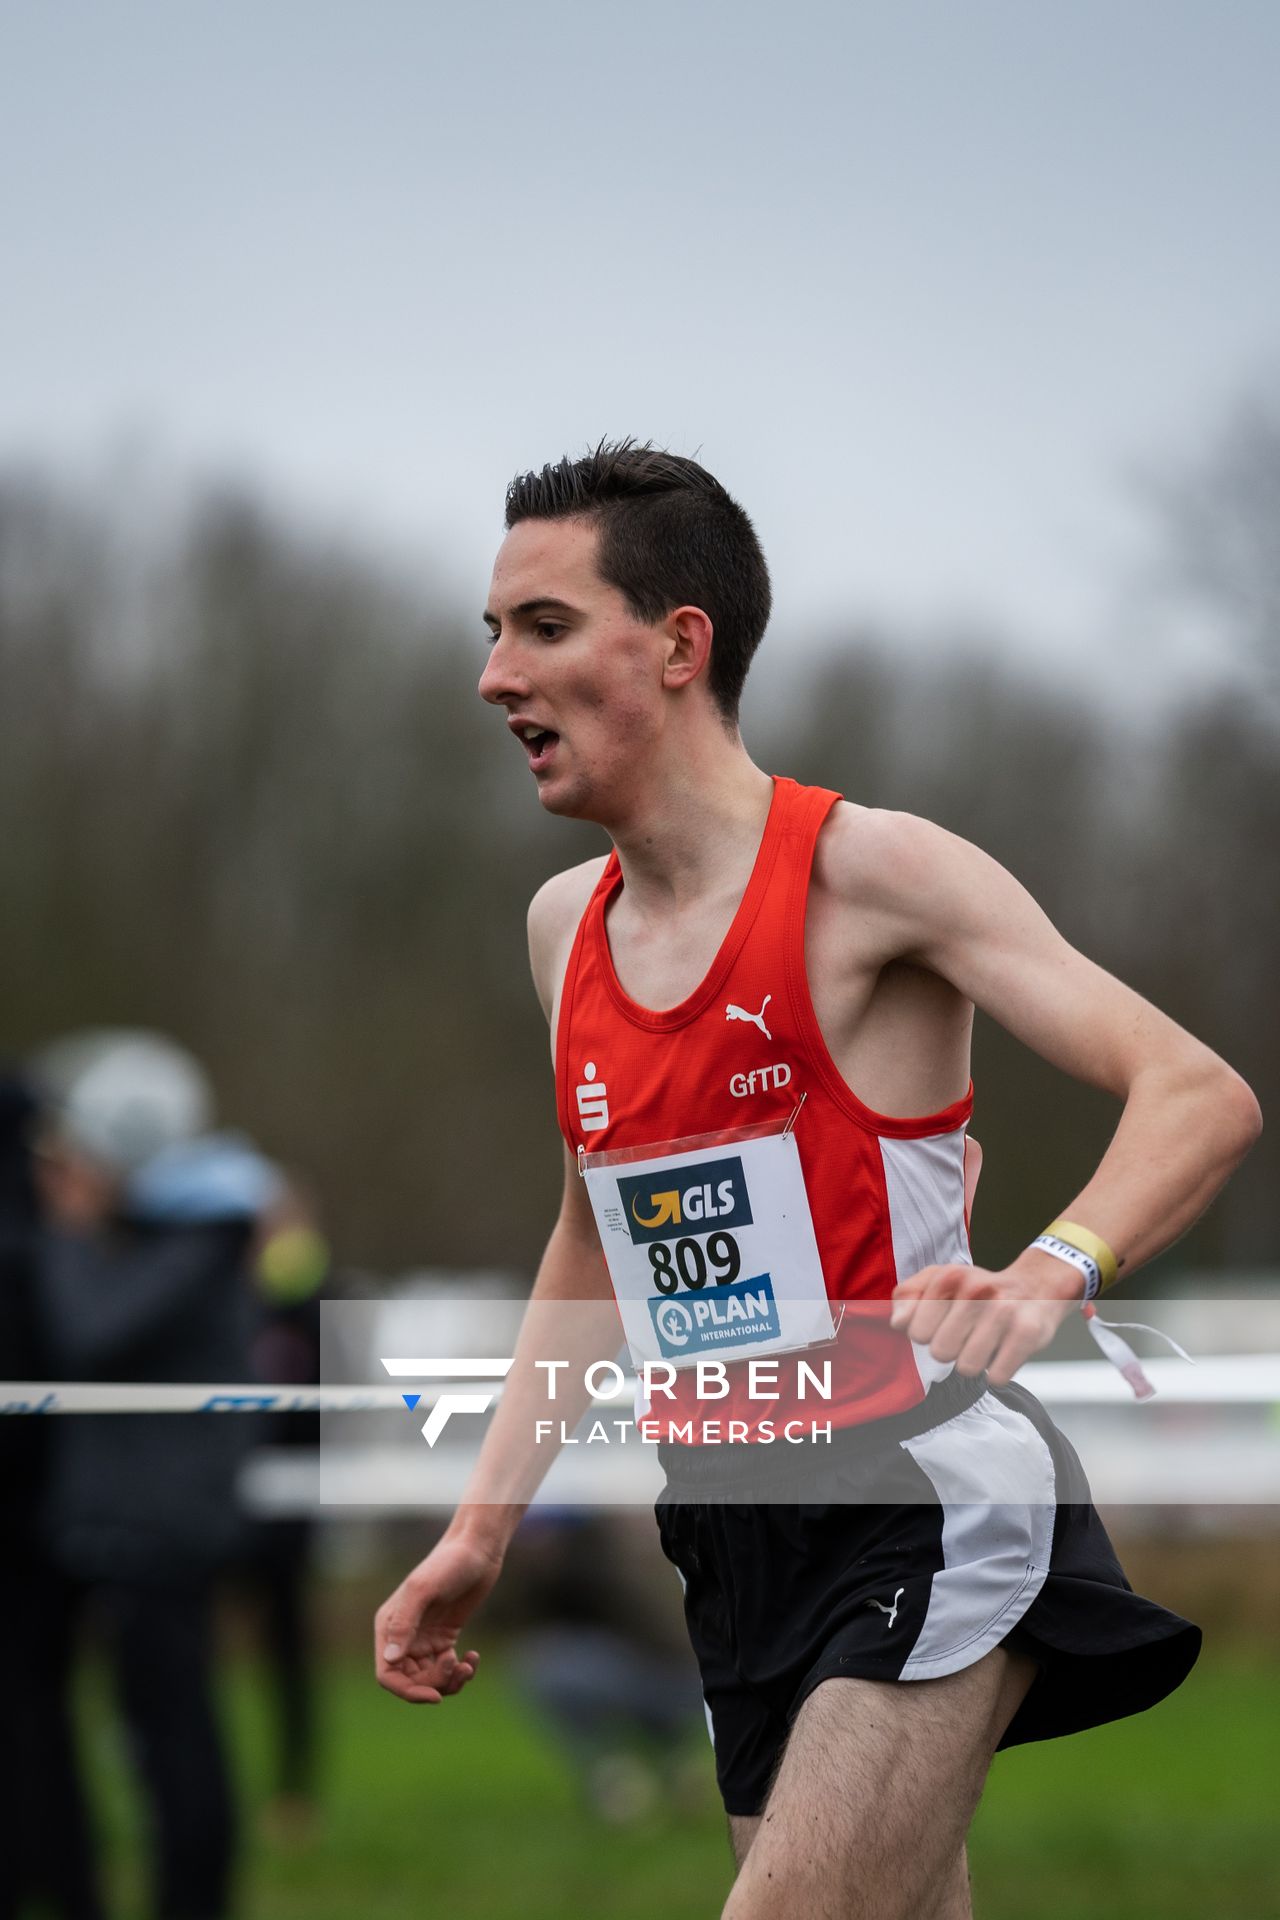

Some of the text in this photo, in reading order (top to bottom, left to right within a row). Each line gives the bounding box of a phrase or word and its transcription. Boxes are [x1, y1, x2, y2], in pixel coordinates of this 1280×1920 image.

[729, 1063, 792, 1099] GfTD
[682, 1179, 736, 1222] GLS
[647, 1231, 742, 1296] 809
[692, 1289, 771, 1329] PLAN
[700, 1321, 773, 1343] INTERNATIONAL
